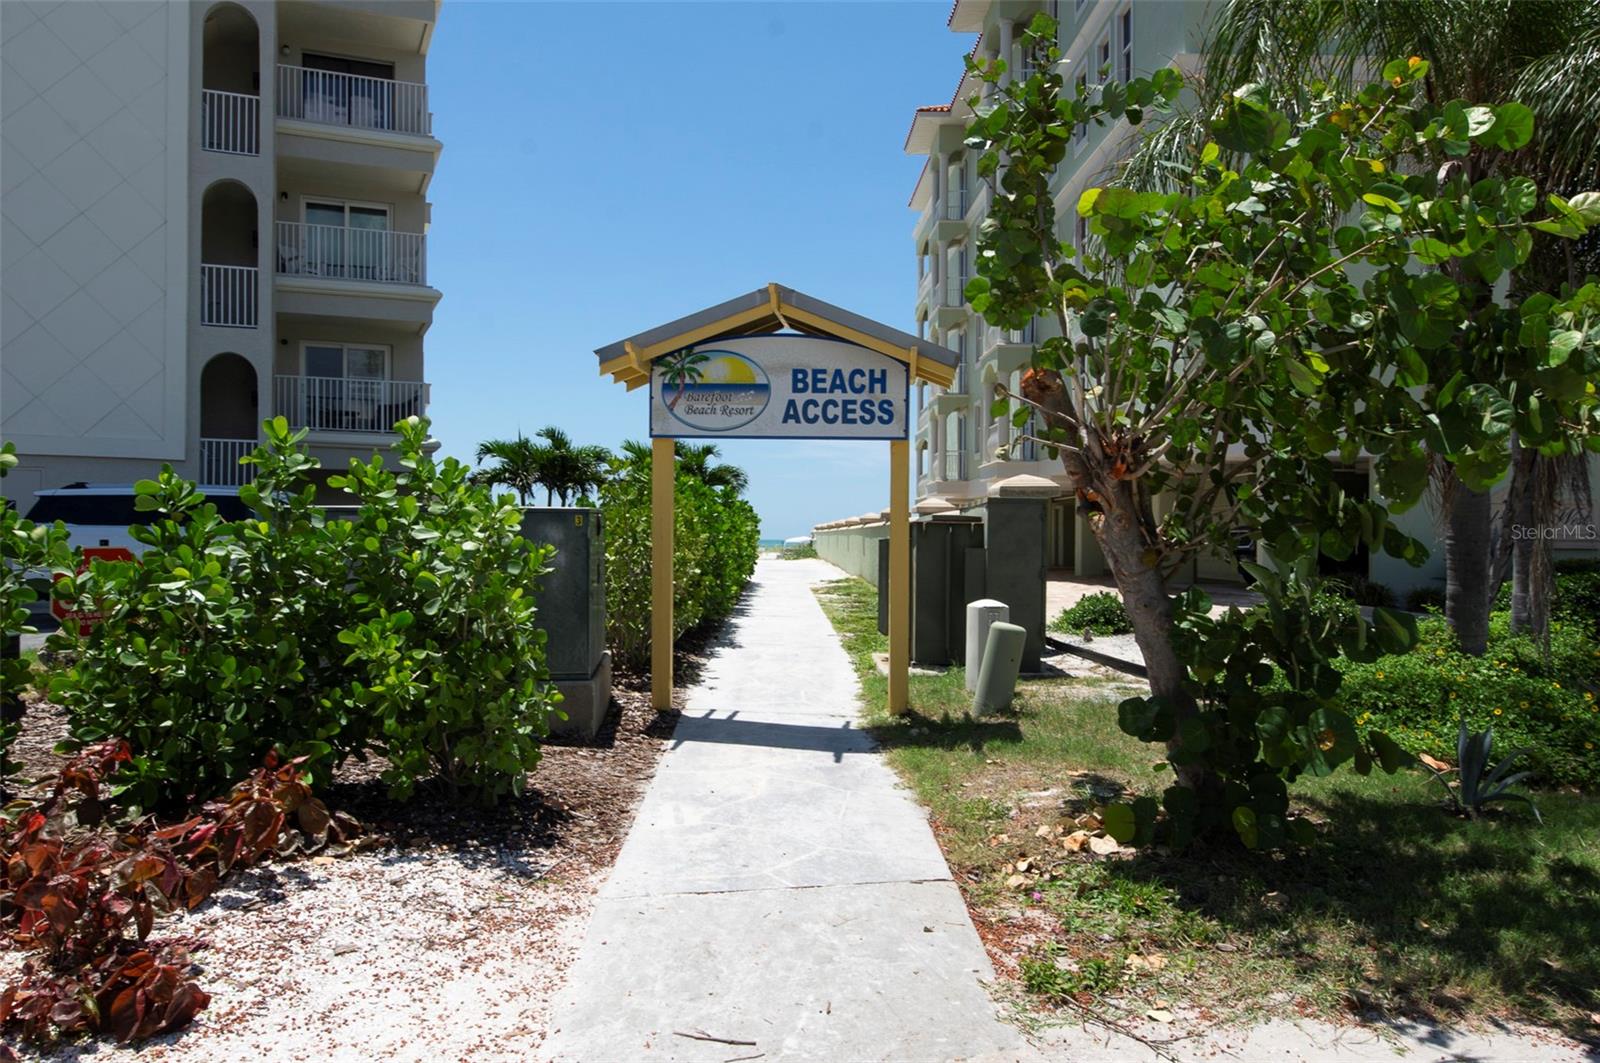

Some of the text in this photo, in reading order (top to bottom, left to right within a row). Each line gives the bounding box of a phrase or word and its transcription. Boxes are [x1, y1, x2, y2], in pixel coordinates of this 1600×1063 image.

[791, 368, 888, 394] BEACH
[686, 392, 733, 405] Barefoot
[684, 404, 755, 417] Beach Resort
[782, 399, 895, 425] ACCESS
